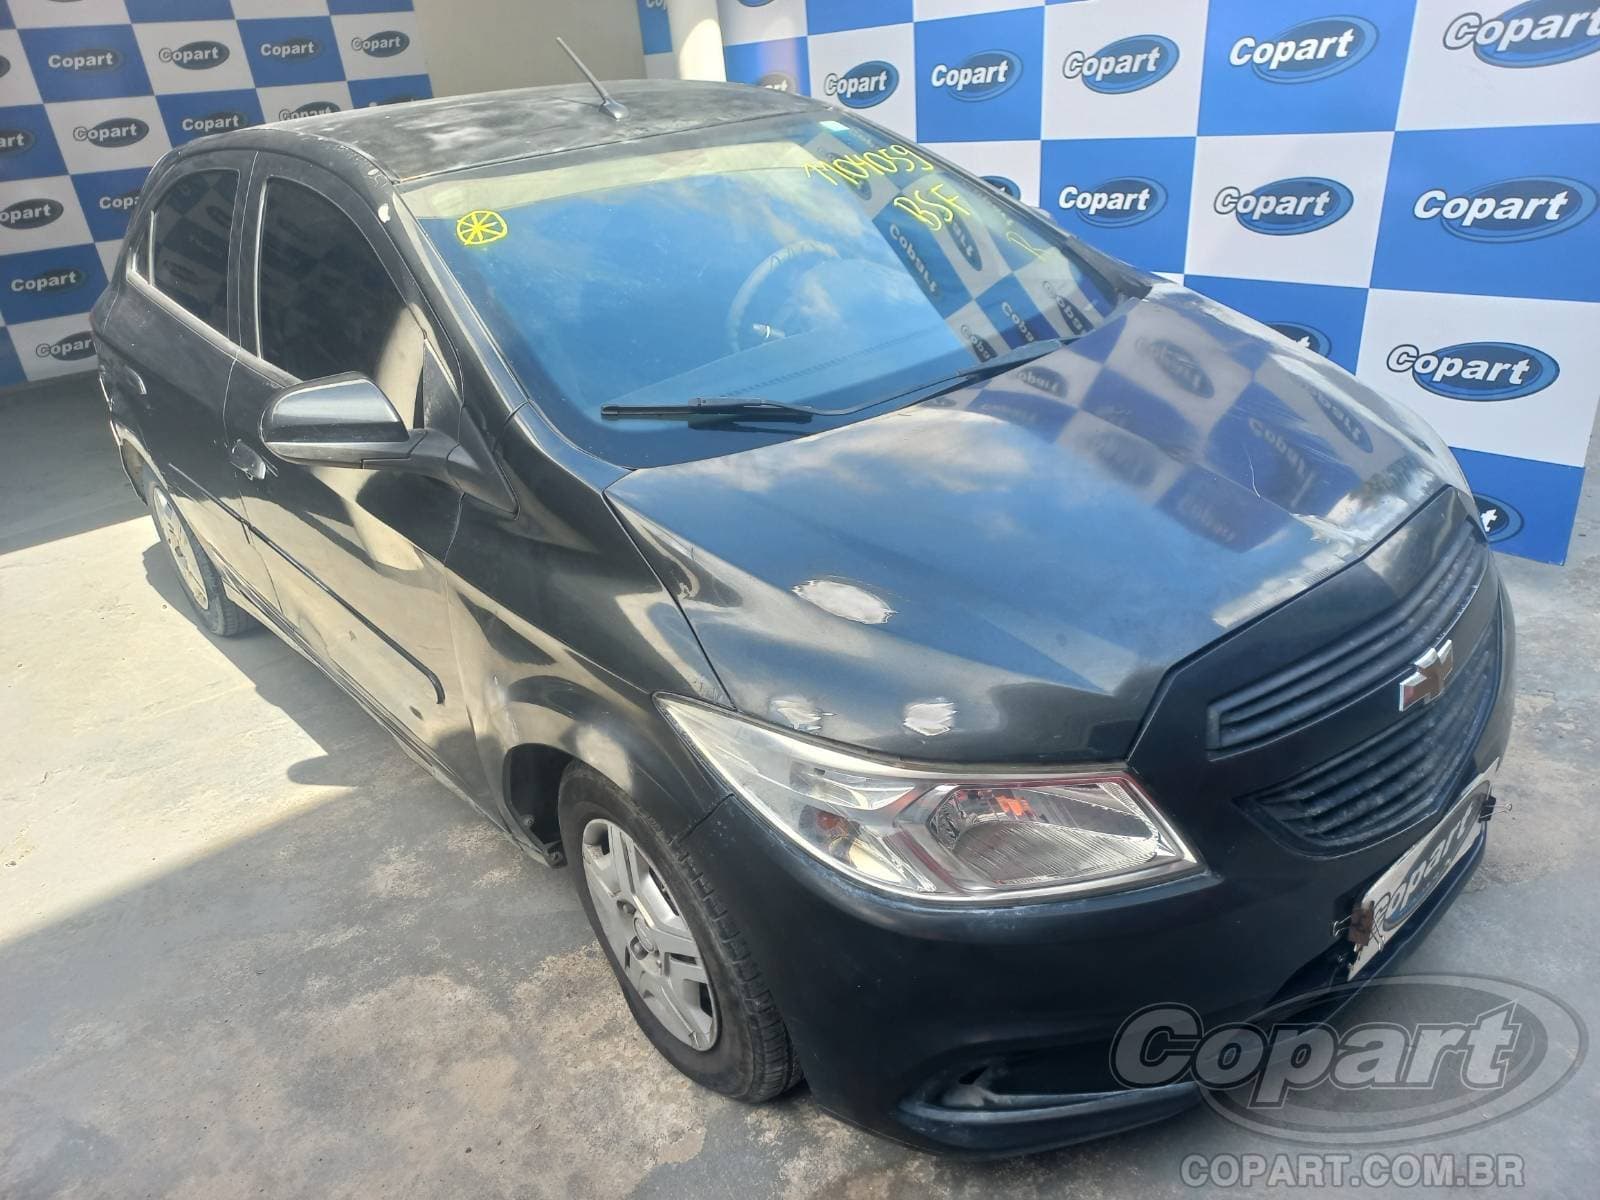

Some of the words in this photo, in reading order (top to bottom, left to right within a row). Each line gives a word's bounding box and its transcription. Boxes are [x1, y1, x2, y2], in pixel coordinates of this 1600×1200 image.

[260, 41, 315, 57] Copart
[352, 35, 401, 51] Copart
[1229, 29, 1355, 70] Copart
[48, 52, 113, 70] Copart
[159, 46, 219, 63] Copart
[1062, 47, 1161, 82] Copart
[931, 56, 1009, 91] Copart
[824, 70, 887, 98] Copart
[73, 123, 137, 142] Copart
[182, 114, 239, 132] Copart
[1059, 184, 1151, 215] Copart
[1214, 186, 1330, 220] Copart
[1413, 189, 1568, 226] Copart
[0, 204, 51, 224] opart
[11, 271, 77, 291] Copart
[36, 339, 92, 357] Copar
[1387, 344, 1532, 385] Copart
